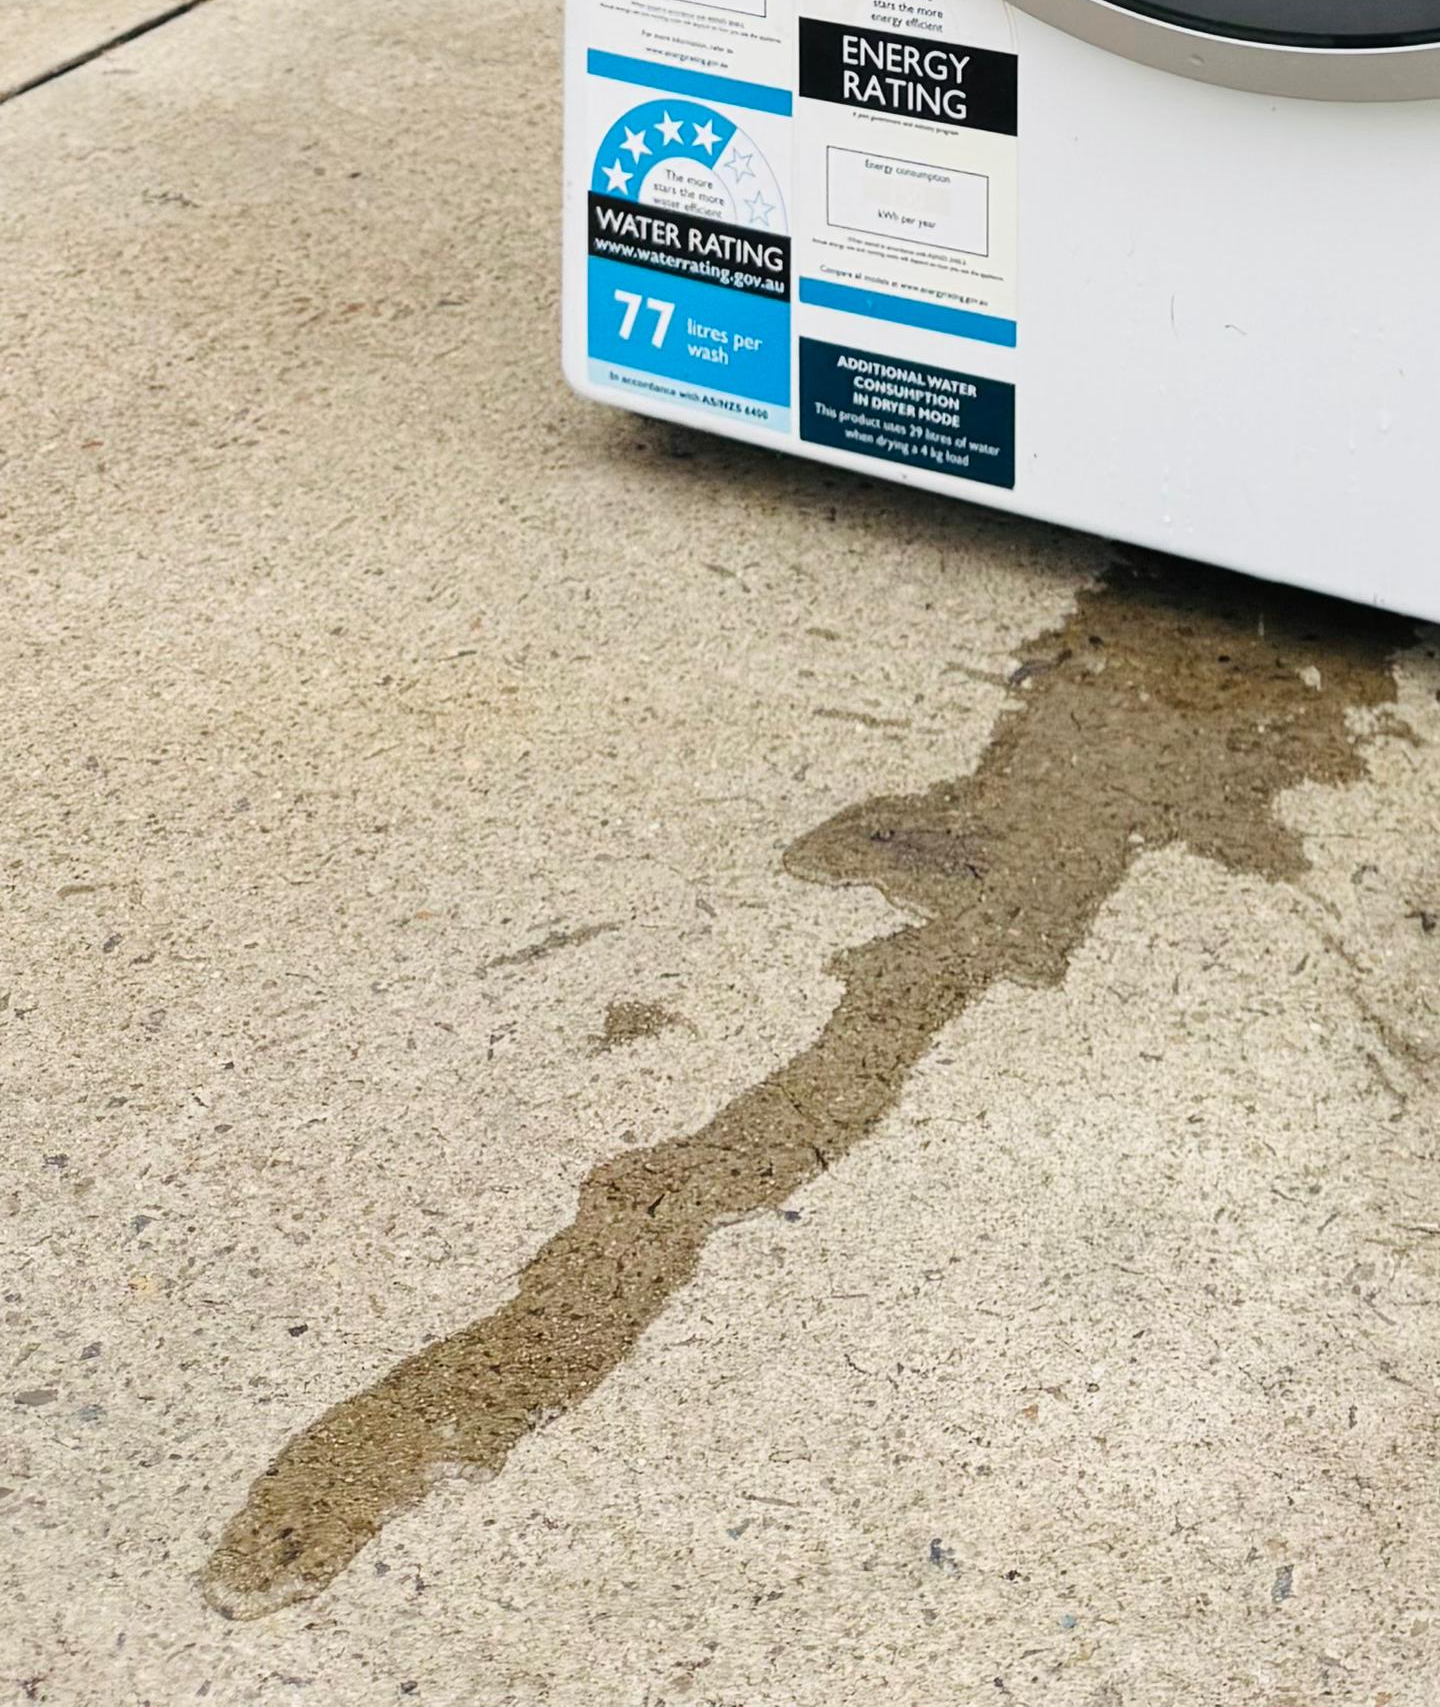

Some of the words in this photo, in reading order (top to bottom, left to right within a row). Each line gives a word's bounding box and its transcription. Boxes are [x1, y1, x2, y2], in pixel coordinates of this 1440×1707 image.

[871, 13, 902, 27] energy
[873, 0, 895, 10] stars
[899, 3, 914, 13] the
[917, 7, 943, 19] more
[842, 35, 970, 84] ENERGY
[843, 70, 967, 120] RATING
[666, 169, 683, 182] The
[687, 177, 712, 189] more
[864, 158, 892, 175] Energy
[895, 167, 951, 184] consumption
[680, 188, 695, 199] the
[699, 194, 724, 205] more
[595, 206, 681, 248] WATER
[688, 228, 784, 272] RATING
[594, 237, 785, 293] www.waterrating.gov.au
[613, 288, 675, 350] 77
[687, 318, 728, 344] litres
[733, 332, 762, 352] per
[687, 344, 729, 366] wash
[836, 355, 925, 387] ADDITIONAL
[926, 374, 977, 398] WATER
[853, 376, 960, 411] CONSUMPTION
[853, 392, 869, 407] IN
[871, 396, 916, 419] DRYER
[918, 407, 960, 429] MODE
[814, 402, 837, 419] This
[839, 407, 881, 429] product
[883, 418, 906, 435] uses
[909, 423, 923, 438] 29
[954, 436, 967, 450] of
[968, 442, 1000, 457] water
[845, 428, 874, 444] when
[875, 434, 910, 455] drying
[920, 444, 928, 455] 4
[946, 449, 969, 467] load
